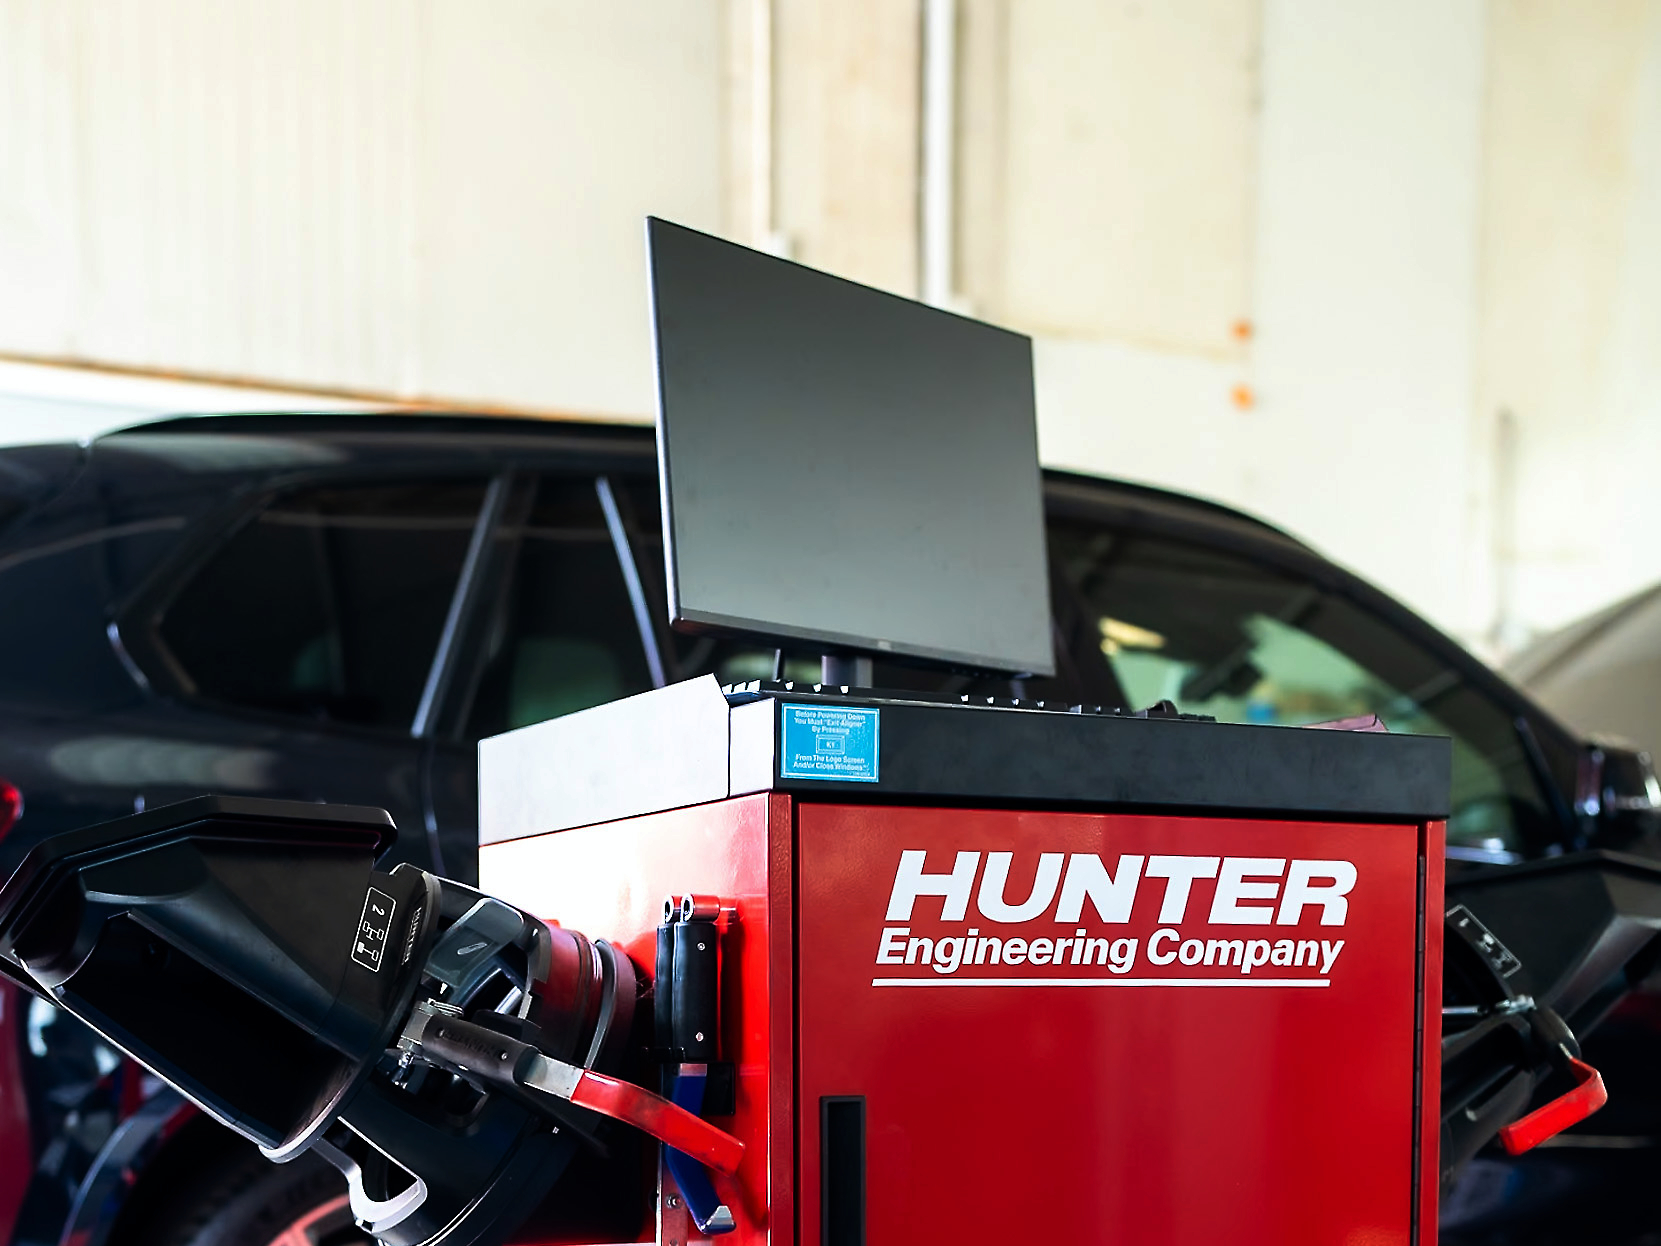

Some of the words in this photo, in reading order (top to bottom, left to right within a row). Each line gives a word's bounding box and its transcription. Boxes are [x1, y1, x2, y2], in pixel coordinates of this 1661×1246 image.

[794, 717, 807, 725] You
[795, 711, 816, 719] Before
[817, 711, 846, 720] Powering
[847, 713, 866, 721] Down
[821, 726, 850, 735] Pressing
[813, 754, 825, 762] The
[843, 756, 865, 764] Screen
[885, 850, 1358, 926] HUNTER
[876, 928, 1138, 974] Engineering
[1147, 928, 1344, 974] Company
